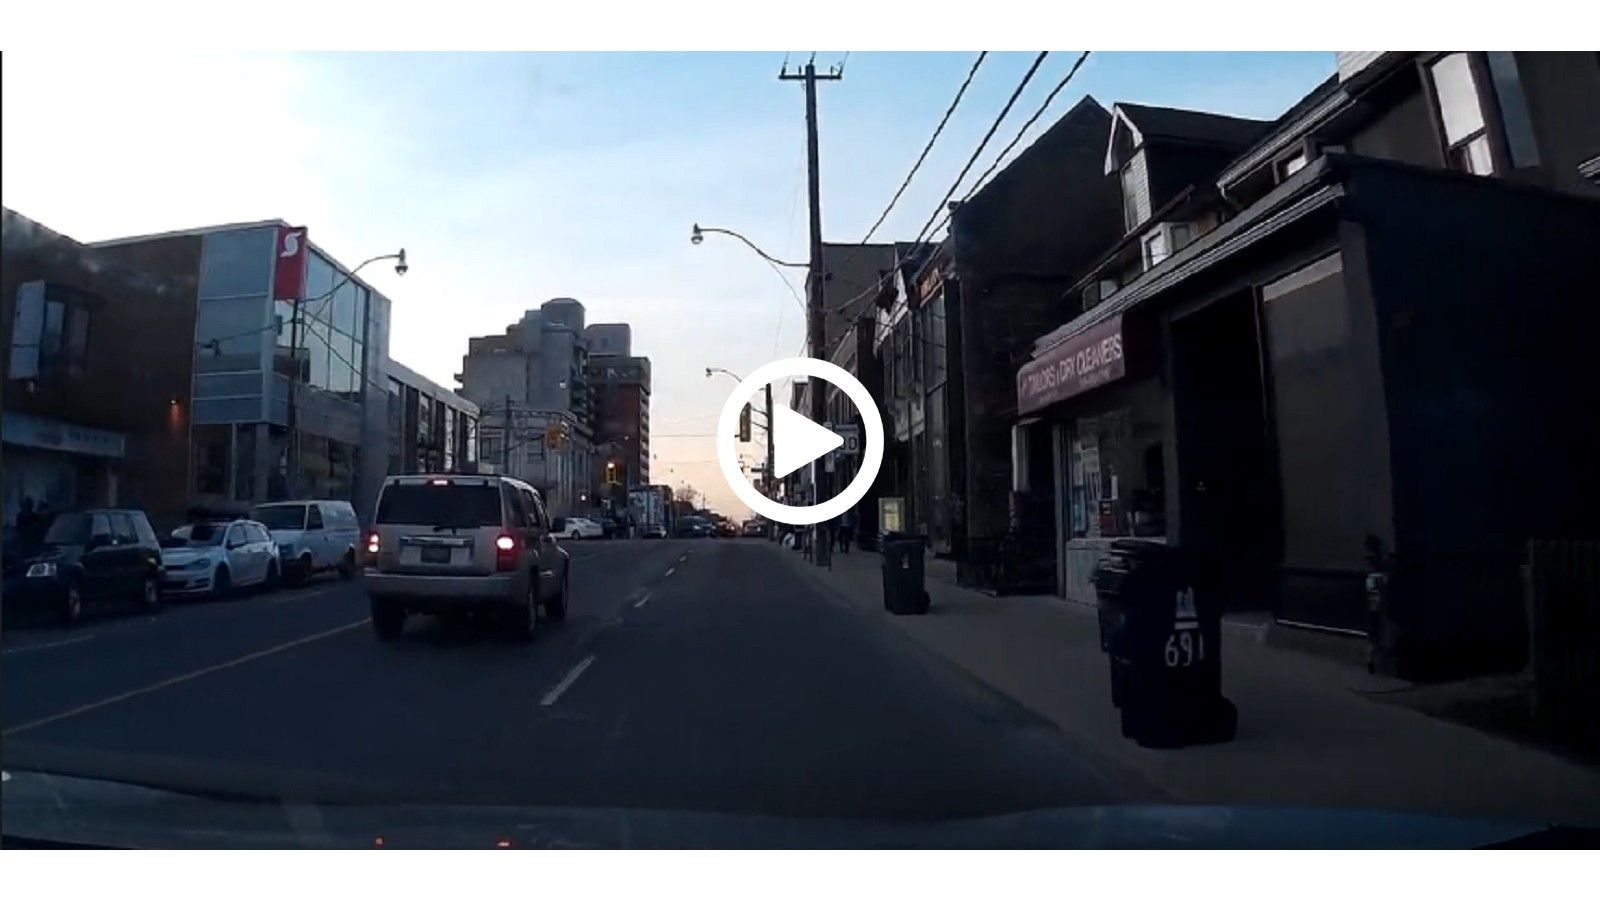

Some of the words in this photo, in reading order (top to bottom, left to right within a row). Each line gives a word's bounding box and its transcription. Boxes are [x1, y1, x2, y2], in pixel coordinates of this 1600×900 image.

[1060, 354, 1076, 382] DRY
[1077, 333, 1123, 375] CLEANERS
[1165, 631, 1204, 666] 691
